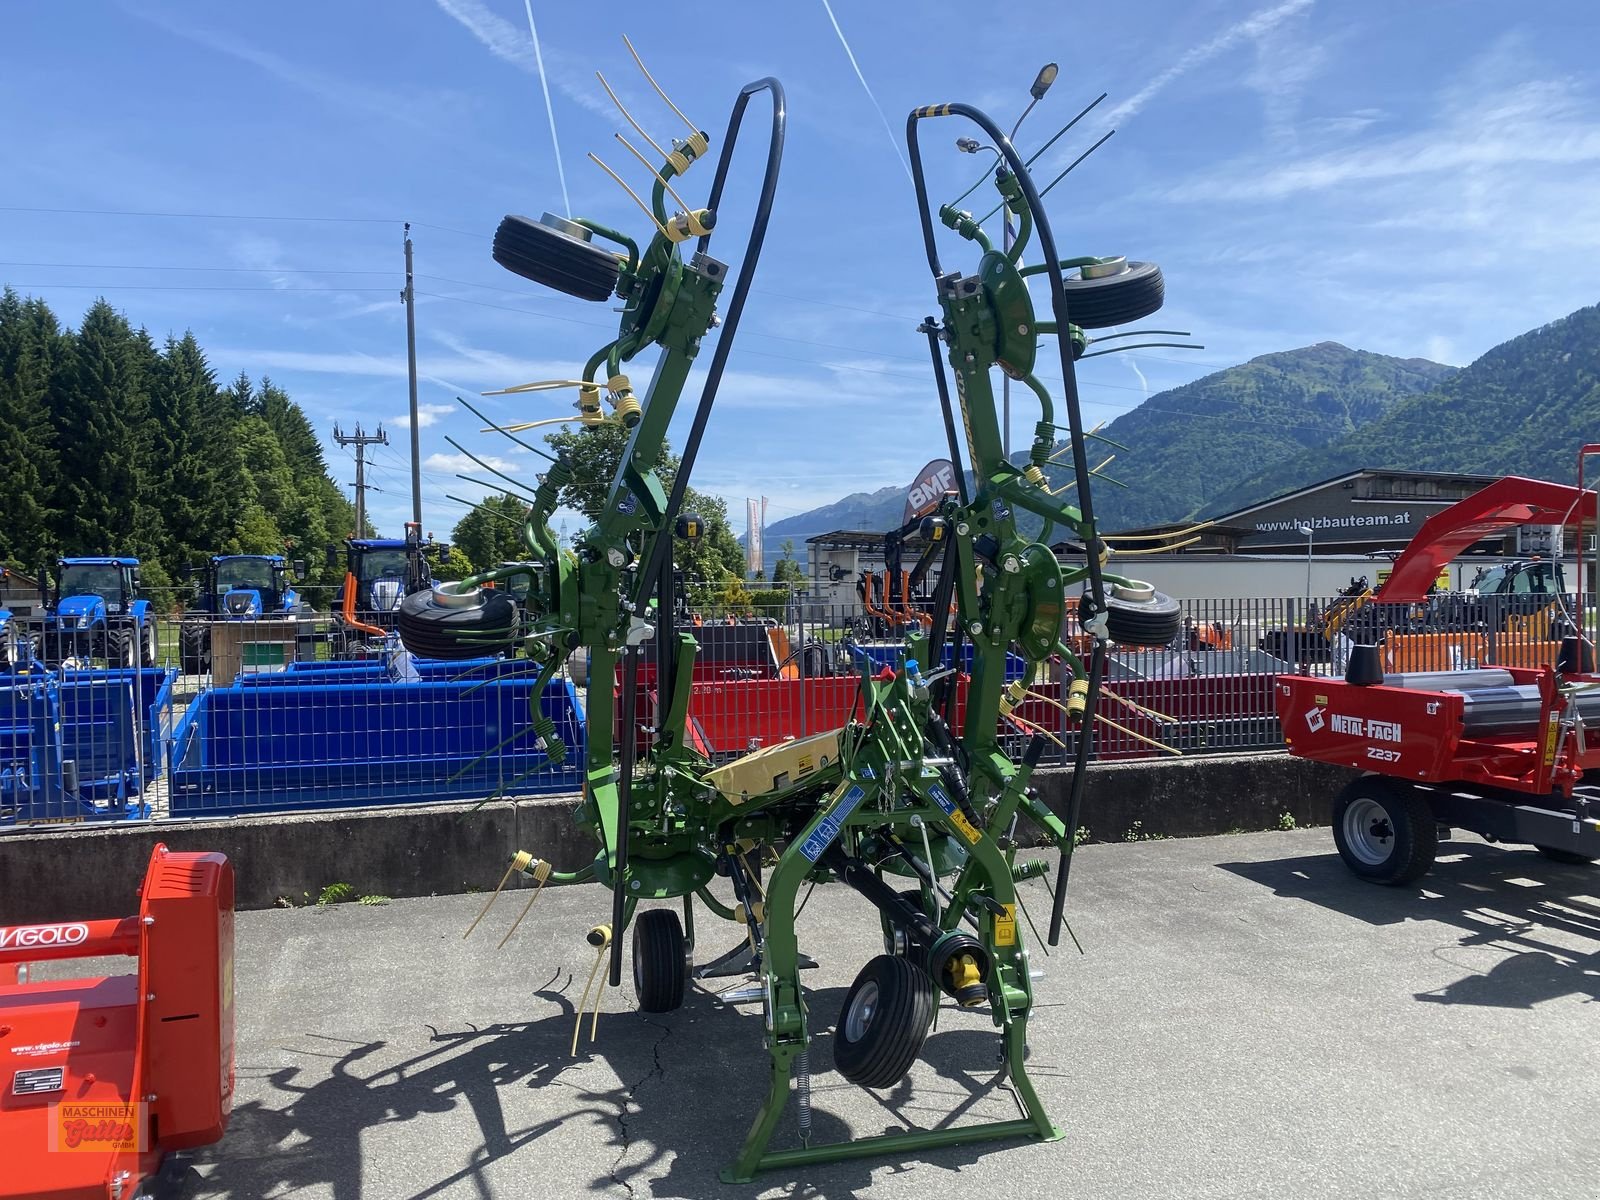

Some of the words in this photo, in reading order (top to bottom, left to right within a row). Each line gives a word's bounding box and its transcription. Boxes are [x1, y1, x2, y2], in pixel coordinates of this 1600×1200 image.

[908, 465, 951, 510] BMF
[1256, 512, 1410, 531] www.holzbauteam.at
[1331, 714, 1402, 743] METAL-FACH
[1367, 747, 1402, 763] Z237
